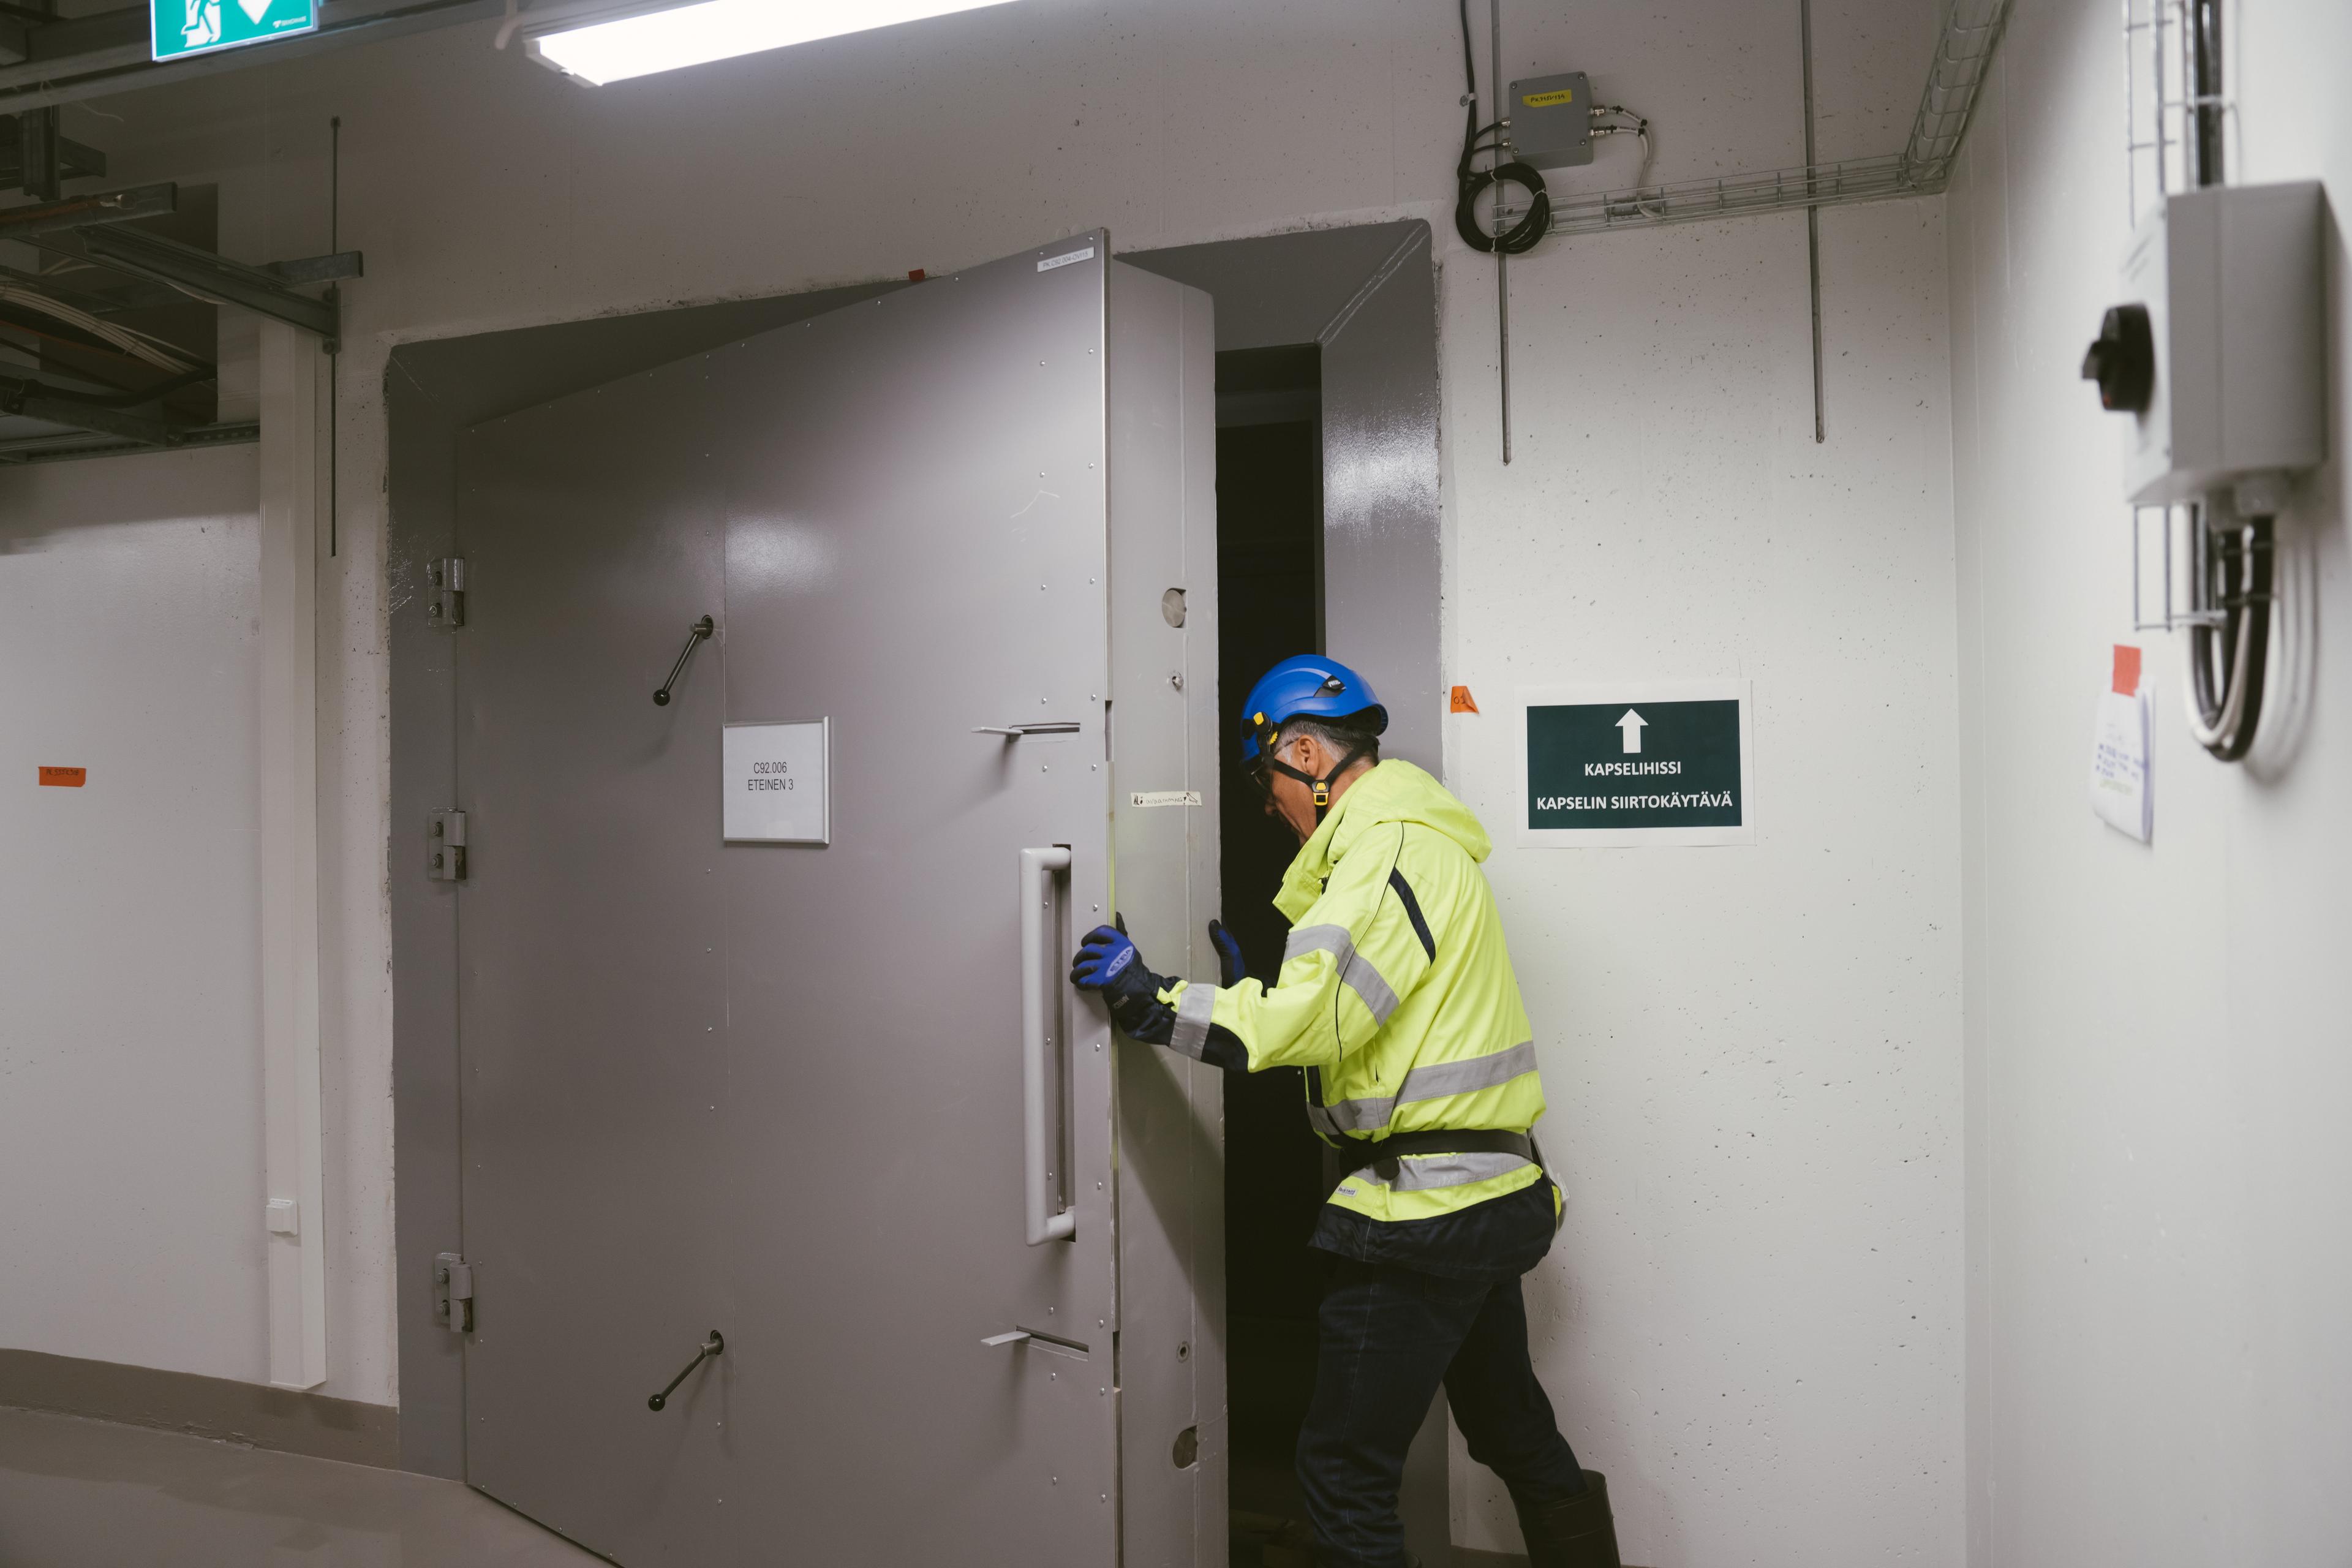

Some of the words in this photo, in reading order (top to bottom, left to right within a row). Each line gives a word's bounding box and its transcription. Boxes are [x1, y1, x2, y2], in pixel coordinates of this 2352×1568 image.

[753, 761, 787, 774] C92.006
[1585, 761, 1681, 776] KAPSELIHISSI
[748, 778, 786, 791] ETEINEN
[788, 778, 794, 790] 3
[1537, 796, 1607, 810] KAPSELIN
[1611, 790, 1733, 809] SIIRTOKÄYTÄVÄ
